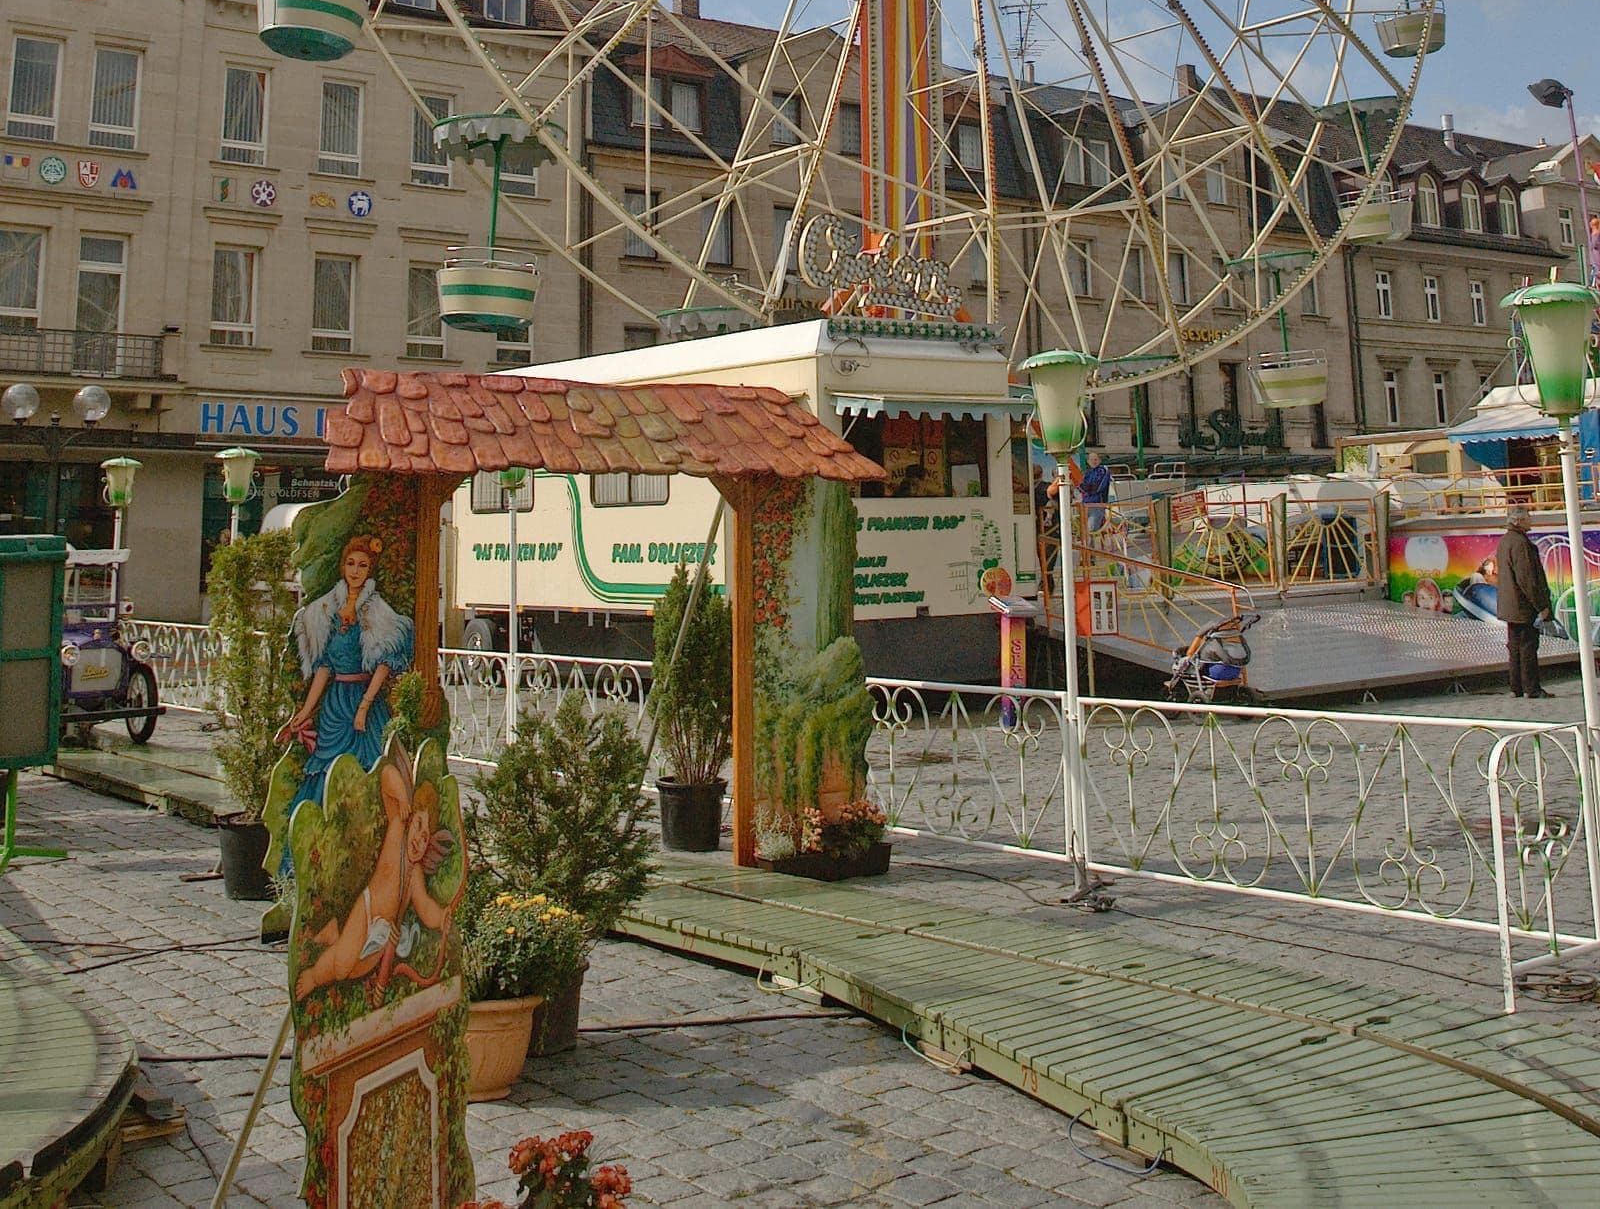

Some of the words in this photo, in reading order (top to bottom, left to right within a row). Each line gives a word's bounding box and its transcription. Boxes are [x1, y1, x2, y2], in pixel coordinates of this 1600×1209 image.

[201, 402, 299, 437] HAUS
[866, 516, 929, 532] FRANKEN
[494, 542, 536, 562] FRAKEN
[611, 542, 644, 564] FAM.
[854, 572, 909, 589] RLICZEK
[1021, 1063, 1039, 1093] 79
